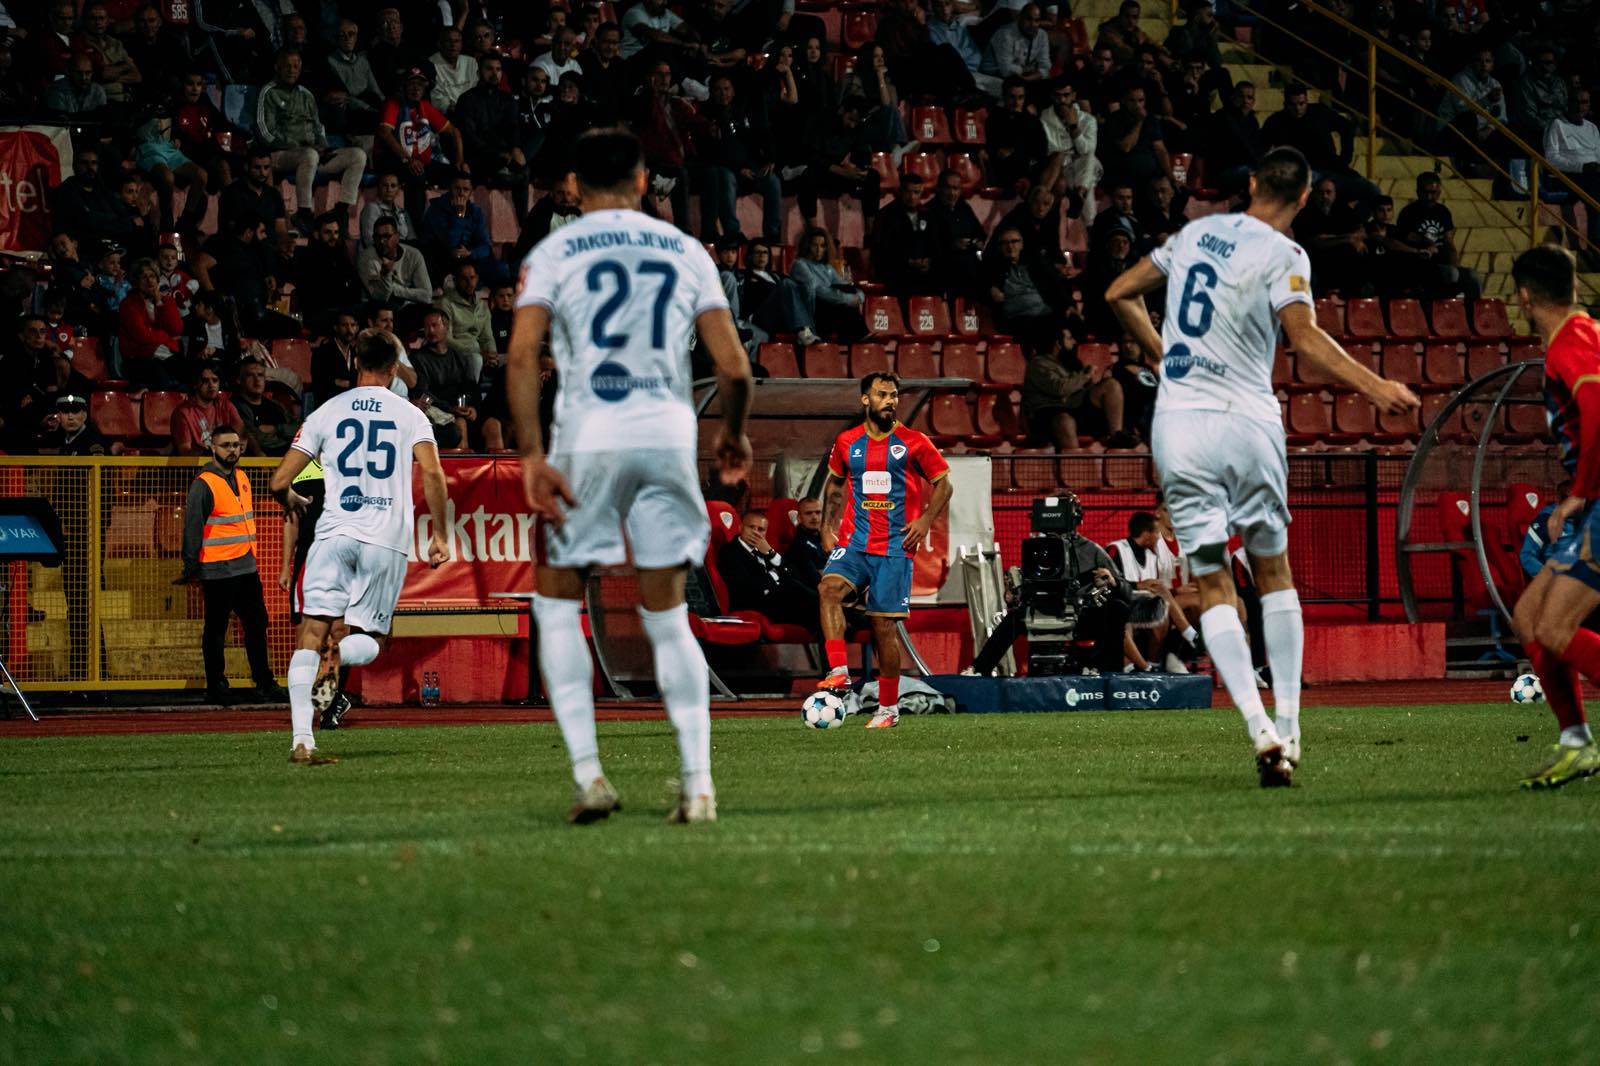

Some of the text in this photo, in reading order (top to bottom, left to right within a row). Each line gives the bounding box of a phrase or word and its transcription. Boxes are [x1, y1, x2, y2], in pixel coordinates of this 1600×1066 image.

[171, 4, 188, 20] 585
[1197, 232, 1238, 260] SAVIĆ
[586, 259, 679, 350] 27
[1178, 261, 1219, 339] 6
[351, 398, 383, 413] ĆUŽE
[336, 418, 398, 480] 25
[863, 501, 893, 509] MOZZART
[9, 527, 40, 539] VAR
[408, 498, 536, 563] ktar
